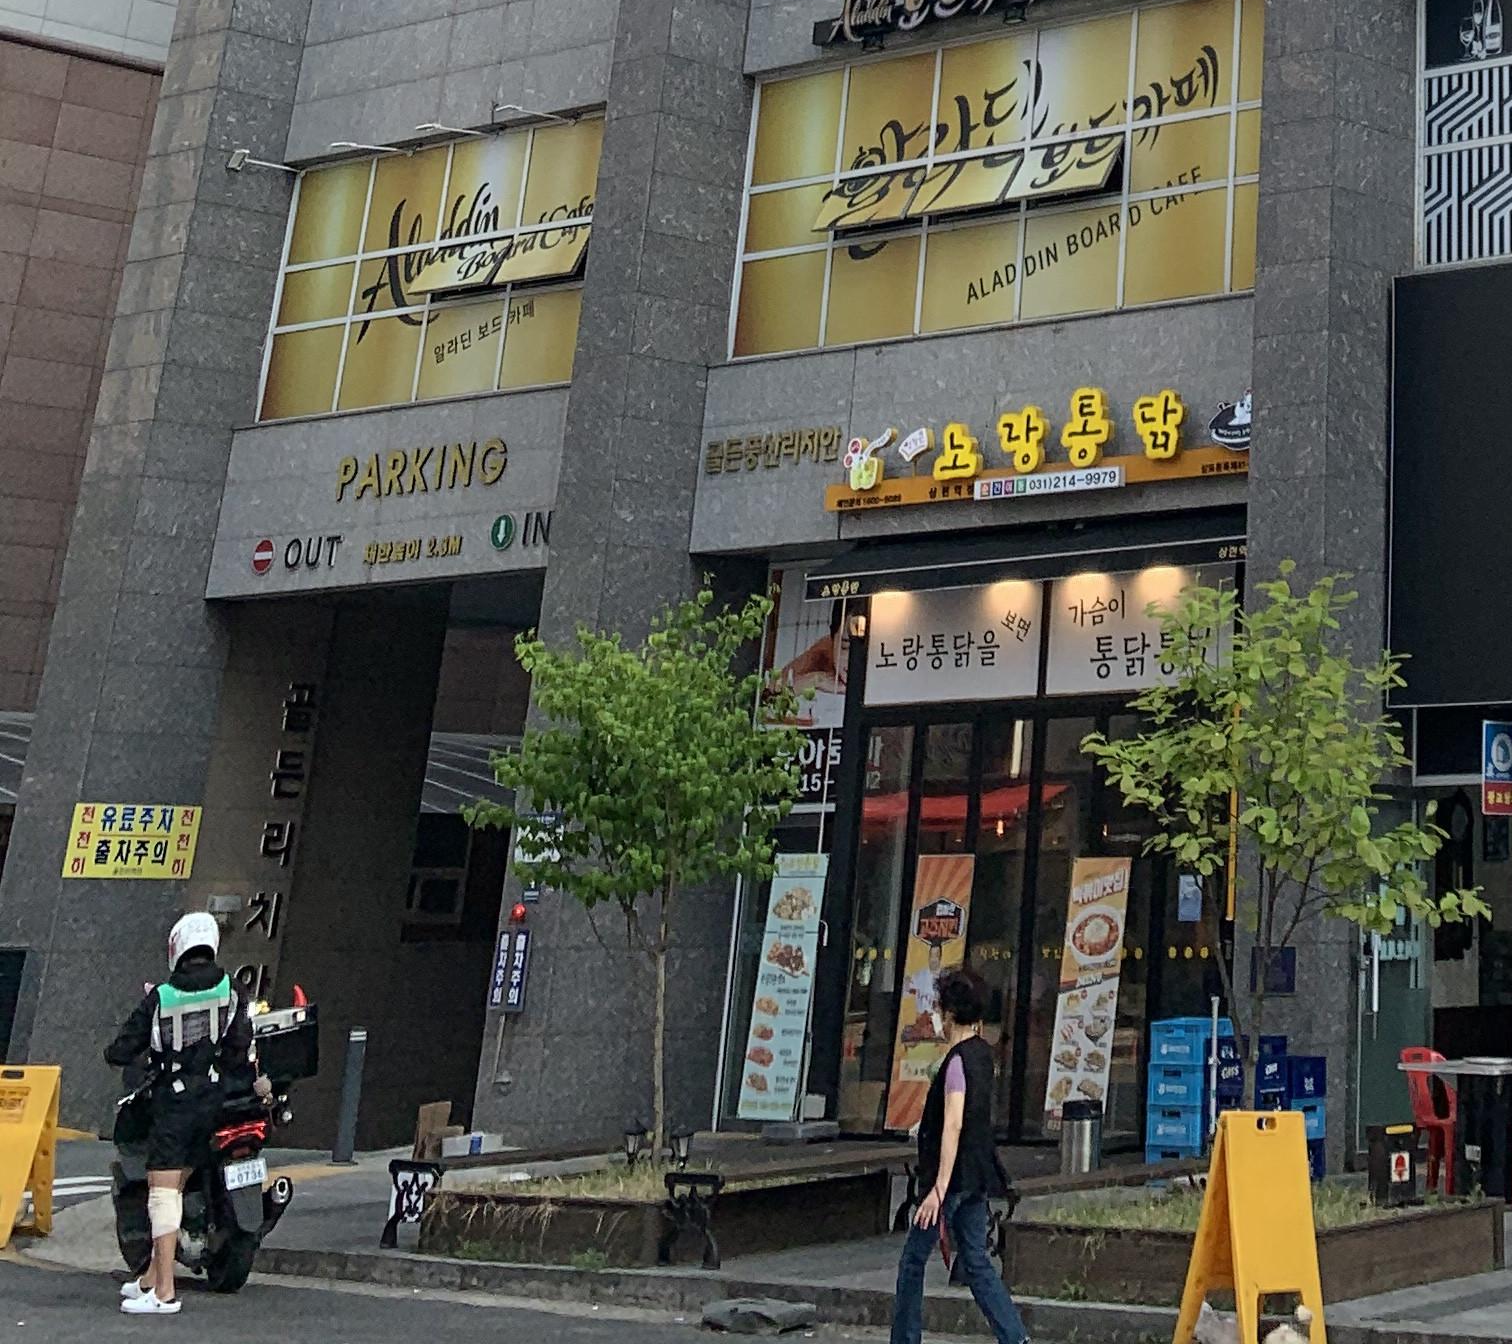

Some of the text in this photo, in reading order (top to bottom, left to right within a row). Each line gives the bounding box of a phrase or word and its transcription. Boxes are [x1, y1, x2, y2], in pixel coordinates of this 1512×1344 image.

[967, 165, 1203, 304] ALADDIN BOARD CAFE
[336, 438, 508, 503] PARKING
[522, 510, 552, 547] IN
[284, 534, 343, 569] OUT
[1001, 609, 1033, 643] 보면
[1068, 589, 1126, 628] 가슴이
[875, 629, 1001, 672] 노랑통닭을
[101, 805, 175, 833] 유료주차
[94, 839, 169, 866] 출차주의
